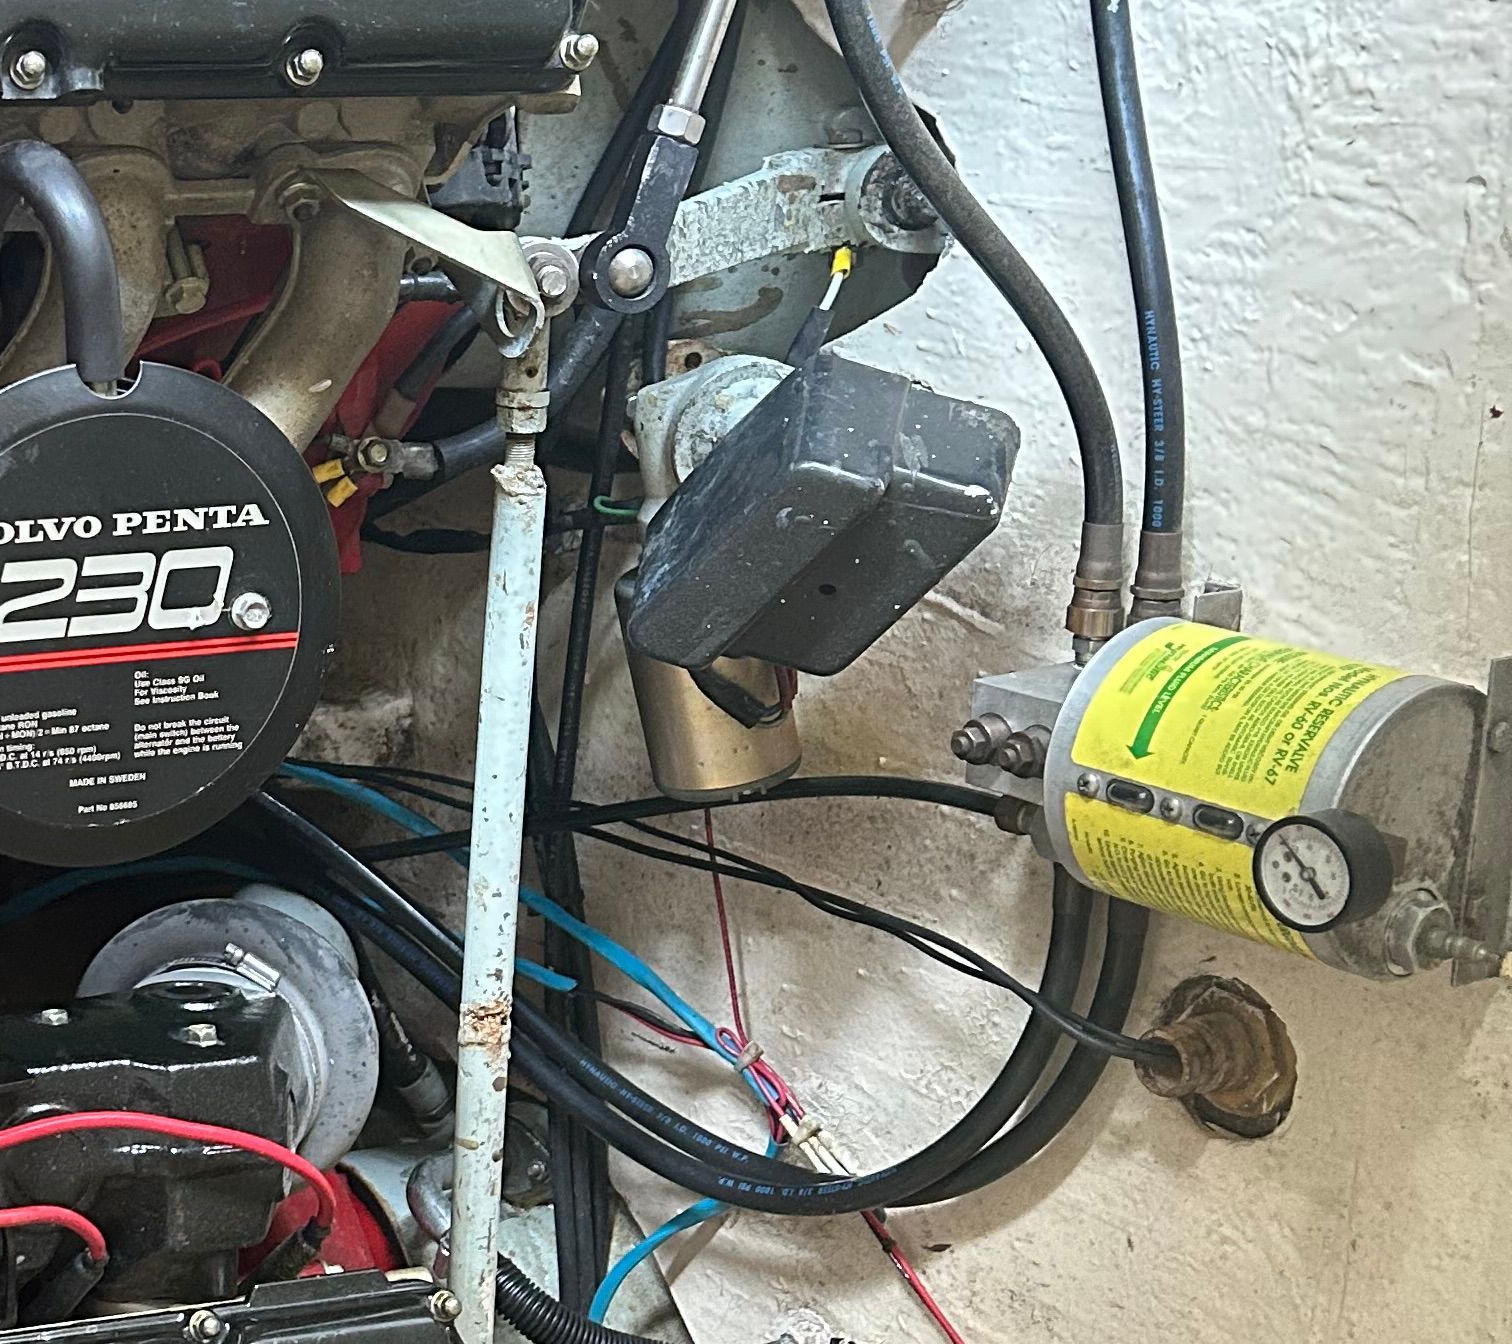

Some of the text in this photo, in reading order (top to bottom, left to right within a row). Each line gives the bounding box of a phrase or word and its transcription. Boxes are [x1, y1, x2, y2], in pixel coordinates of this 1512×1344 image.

[1144, 310, 1160, 371] HYNAUTIC
[1154, 440, 1164, 461] 3/8
[1154, 471, 1164, 490] I.D.
[112, 503, 270, 537] PENTA
[1152, 500, 1163, 528] 1000
[134, 674, 205, 688] Use Class SG Oil
[134, 685, 187, 697] For Viscosity
[134, 690, 219, 705] See Instruction Book
[1152, 691, 1171, 714] LEVEL
[1, 712, 40, 723] unleaded
[42, 708, 77, 720] gasoline
[1292, 701, 1322, 730] RV-60
[18, 720, 38, 729] RON
[51, 726, 67, 735] Min
[69, 725, 79, 733] 87
[82, 723, 110, 732] octane
[134, 716, 229, 732] Do not break the circuit
[134, 724, 239, 741] (main switch) between the
[1282, 732, 1294, 746] or
[1285, 708, 1334, 773] RESERVALVE
[134, 733, 236, 749] alternator and the battery
[77, 745, 97, 754] rpm)
[134, 749, 156, 758] while
[158, 747, 171, 755] the
[173, 744, 200, 755] engine
[212, 741, 243, 751] running
[53, 757, 63, 765] 74
[1265, 748, 1288, 786] RV-67
[69, 772, 146, 787] MADE IN SWEDEN
[78, 803, 107, 814] Part No
